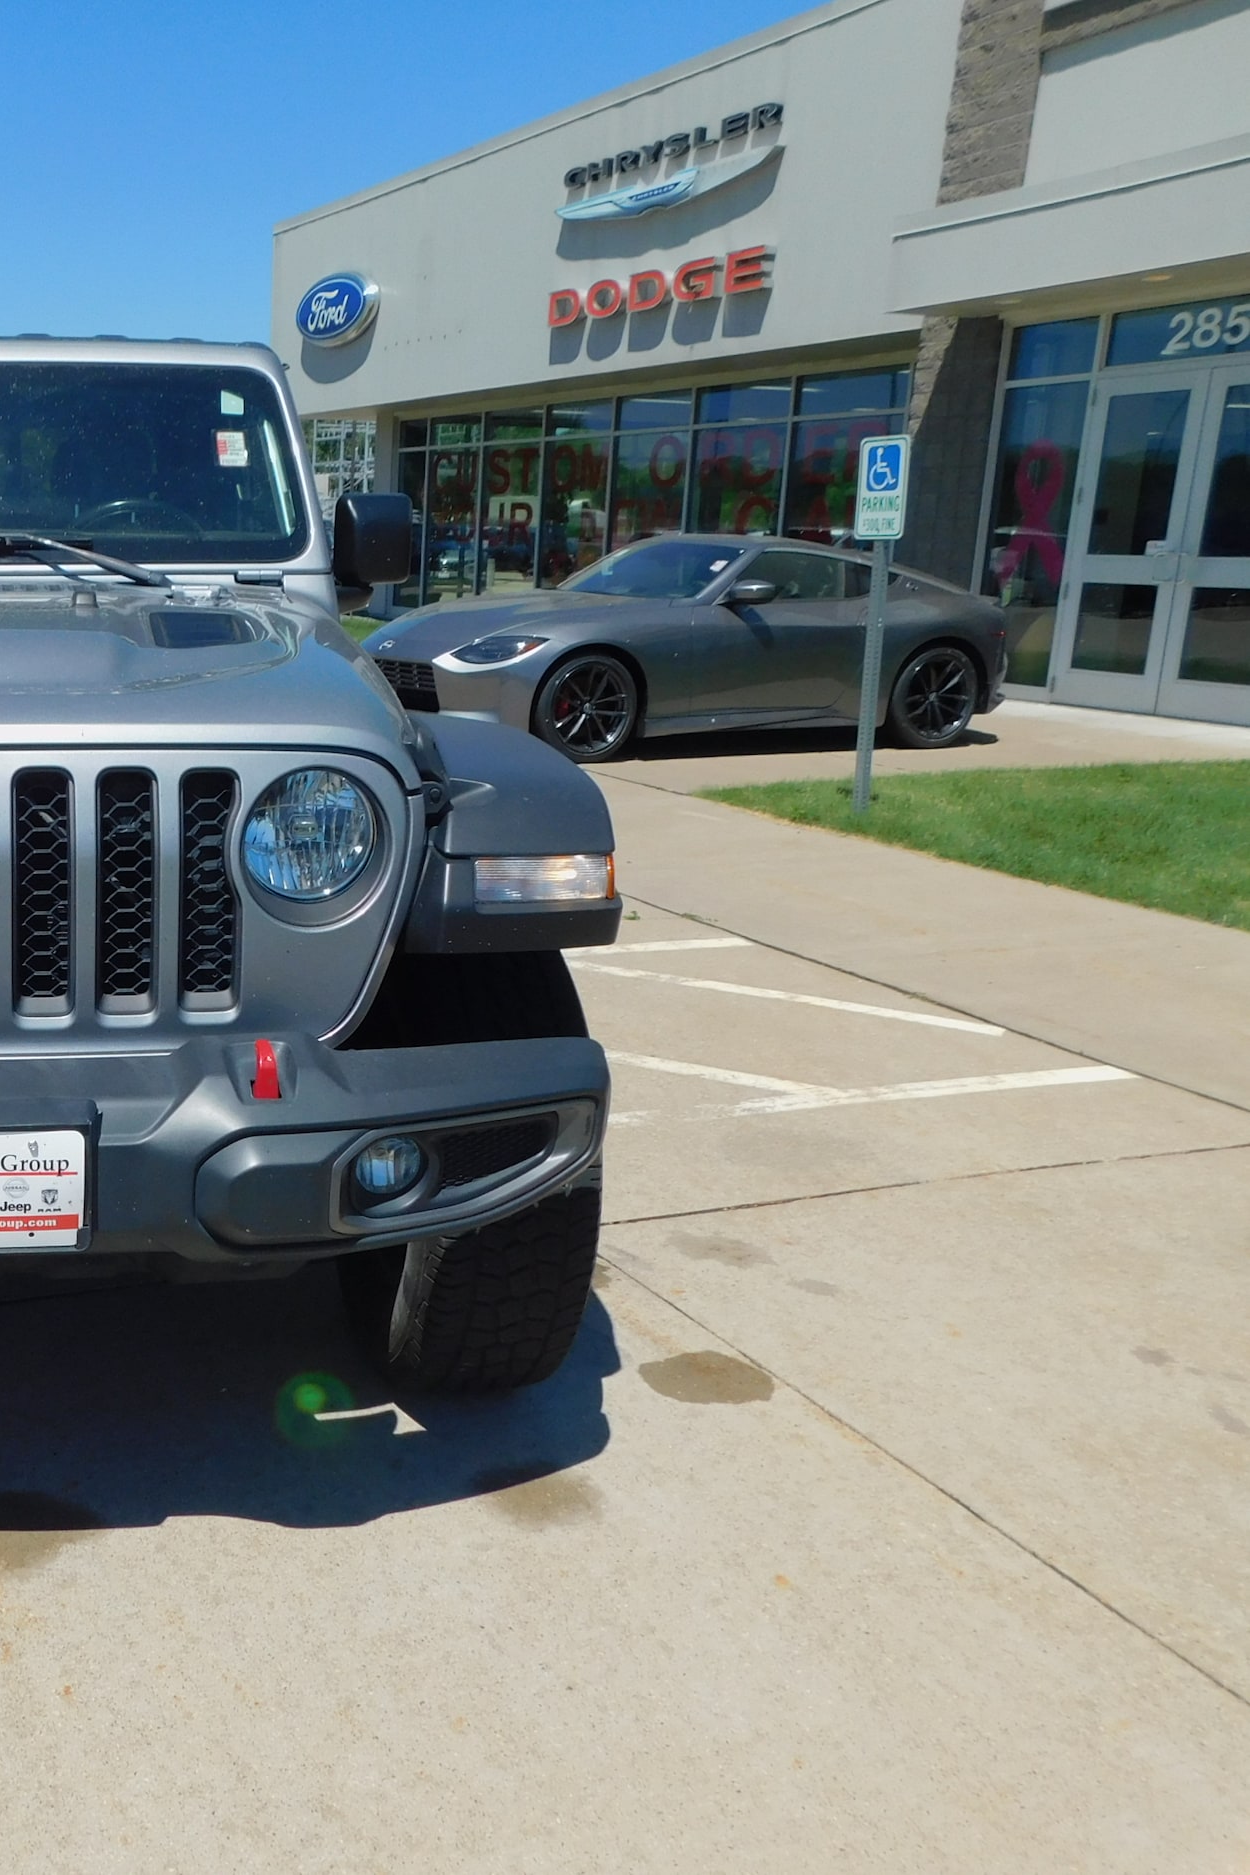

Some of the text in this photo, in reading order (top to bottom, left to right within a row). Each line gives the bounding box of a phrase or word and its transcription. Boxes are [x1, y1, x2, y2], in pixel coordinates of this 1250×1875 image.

[564, 102, 784, 189] CHRYSLER
[548, 245, 775, 328] DODGE
[307, 288, 350, 333] Ford
[431, 440, 610, 496] CUSTOM
[861, 495, 900, 512] PARKING
[881, 517, 896, 531] FINE
[0, 1154, 70, 1177] Group
[0, 1201, 32, 1214] Jeep
